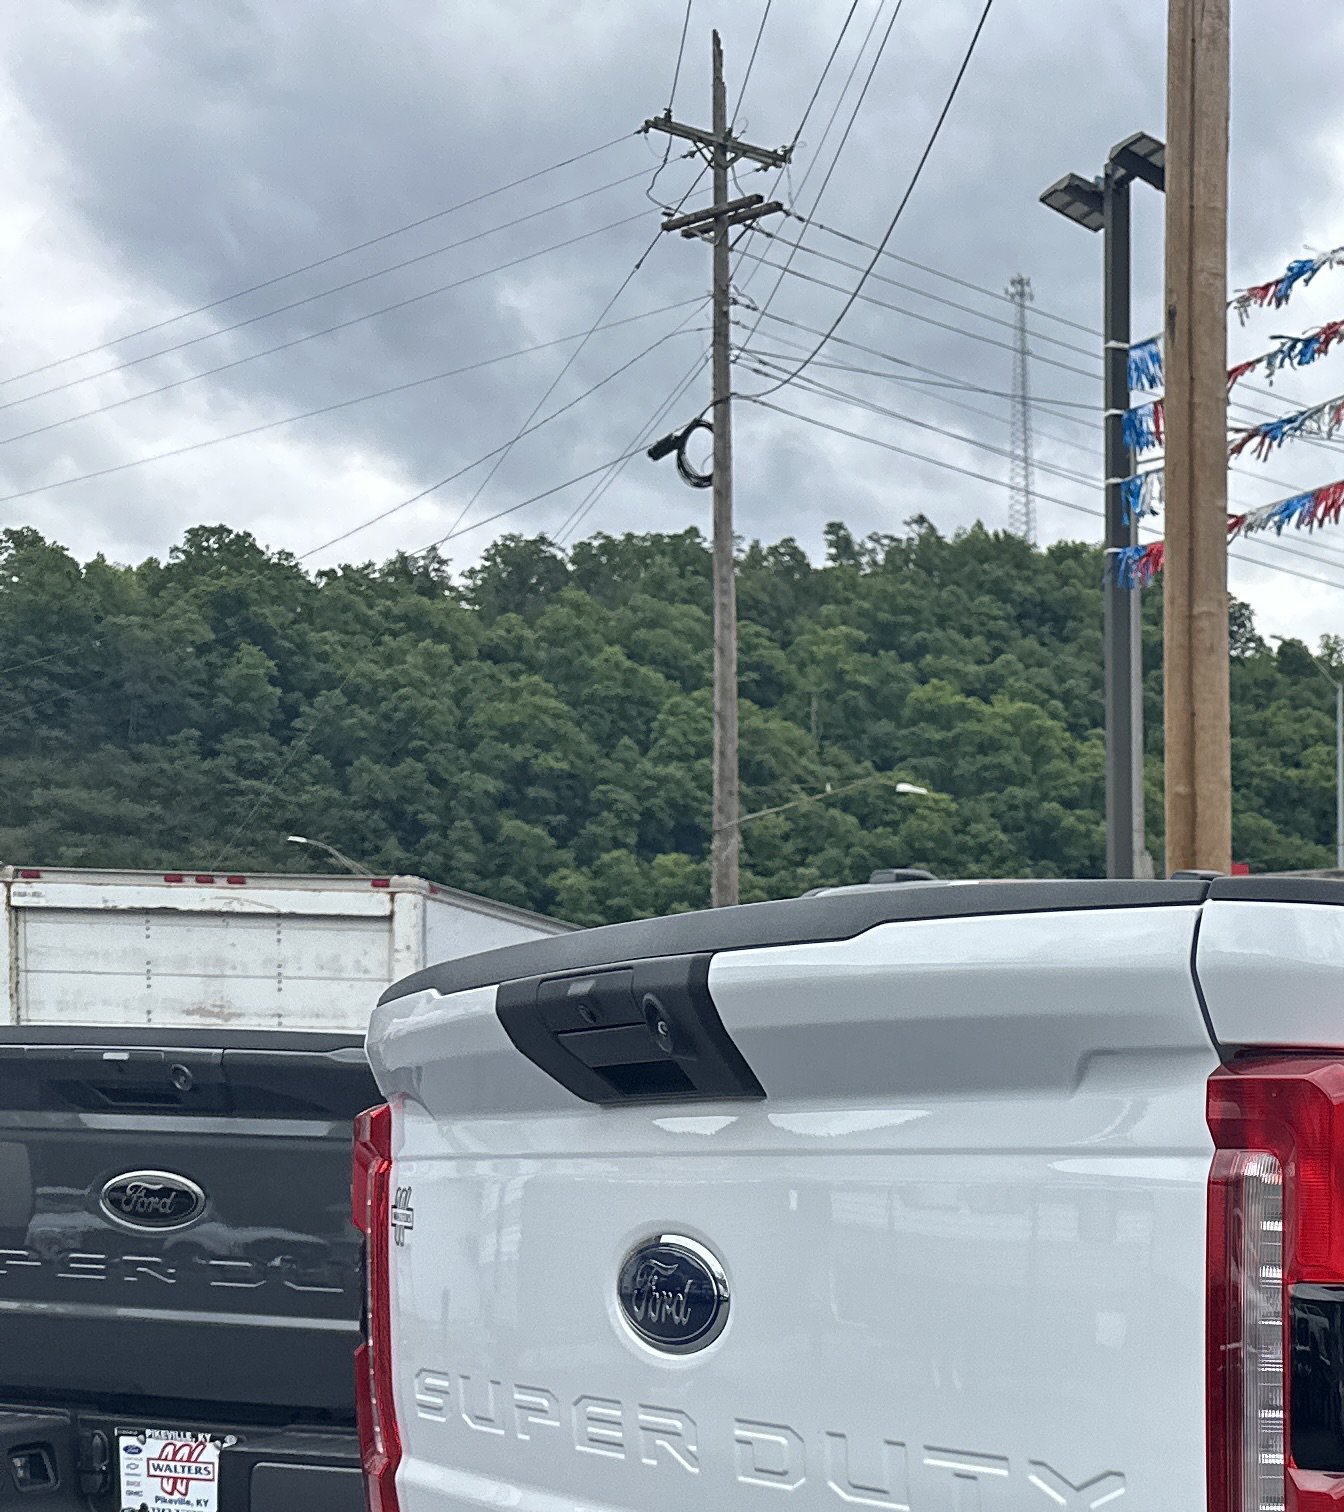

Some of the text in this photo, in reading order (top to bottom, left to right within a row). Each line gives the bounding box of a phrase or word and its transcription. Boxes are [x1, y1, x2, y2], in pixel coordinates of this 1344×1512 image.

[122, 1182, 177, 1214] Ford
[632, 1259, 693, 1326] Ford
[414, 1367, 700, 1475] SUPER
[151, 1462, 212, 1476] WALTERS
[196, 1498, 209, 1507] KY
